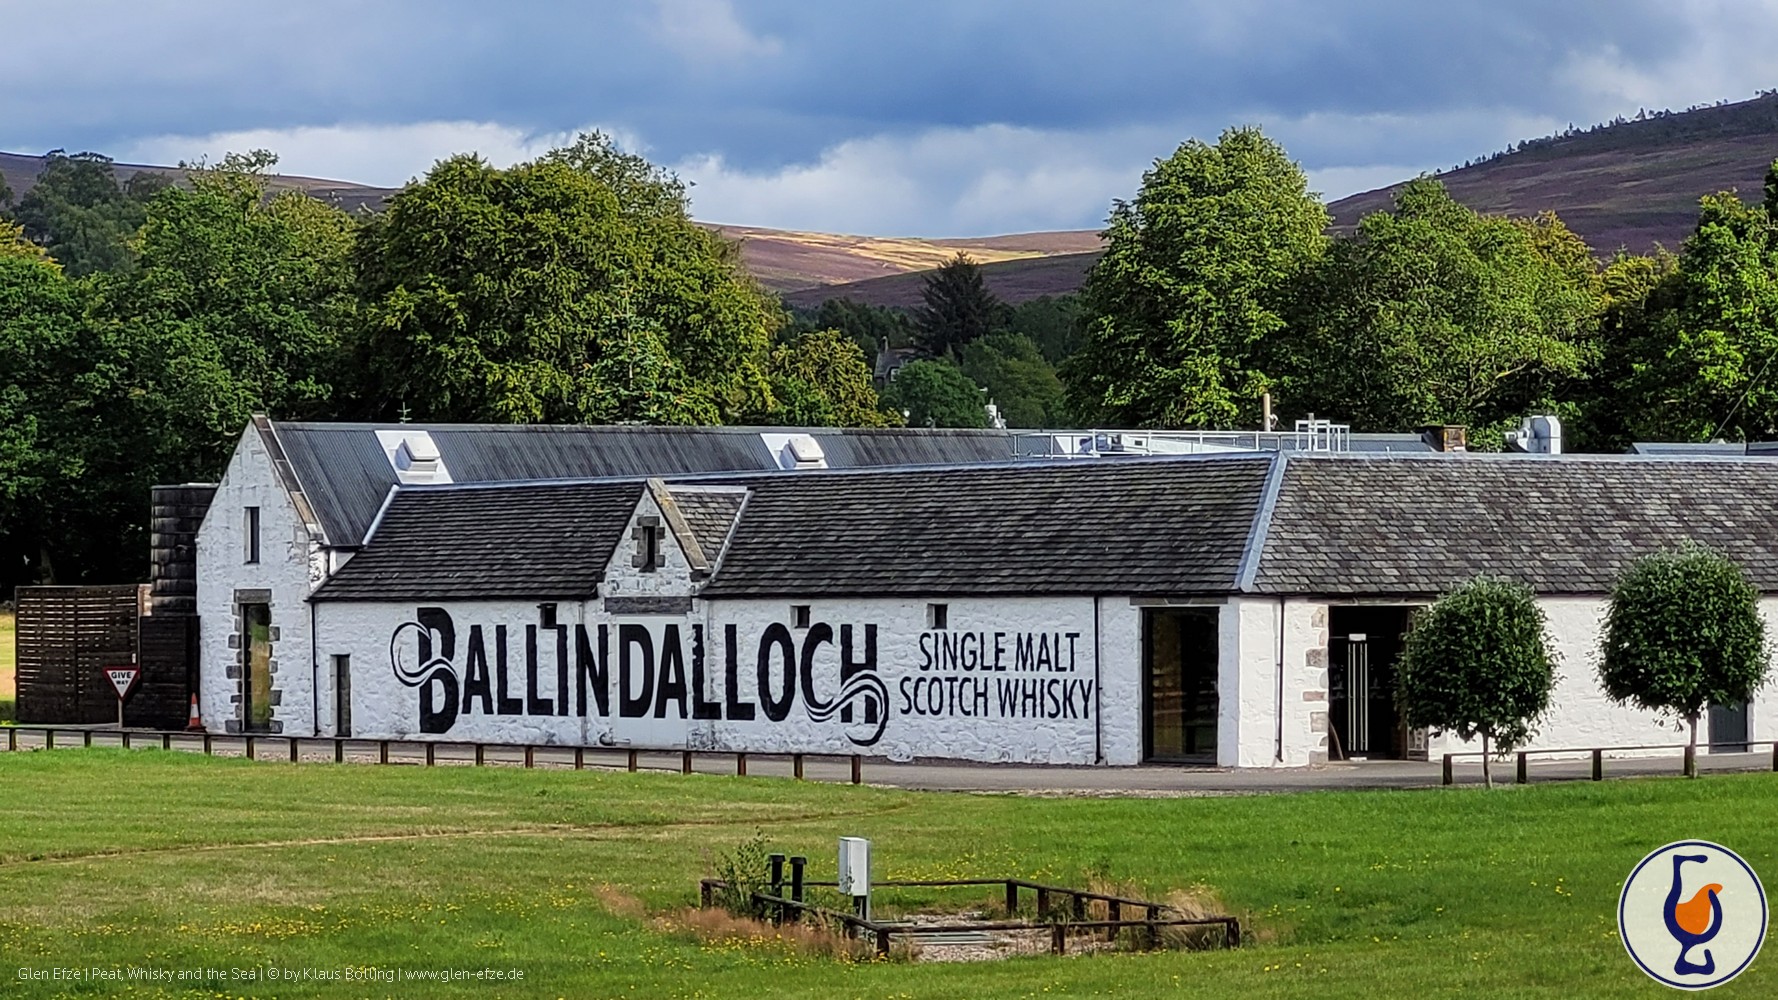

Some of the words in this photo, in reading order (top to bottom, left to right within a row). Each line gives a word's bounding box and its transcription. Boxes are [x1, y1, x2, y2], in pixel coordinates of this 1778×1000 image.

[919, 631, 1006, 672] SINGLE
[1015, 632, 1080, 672] MALT
[111, 671, 132, 679] GIVE
[390, 606, 889, 747] BALLINDALLOCH
[900, 676, 988, 717] SCOTCH
[997, 677, 1093, 719] WHISKY
